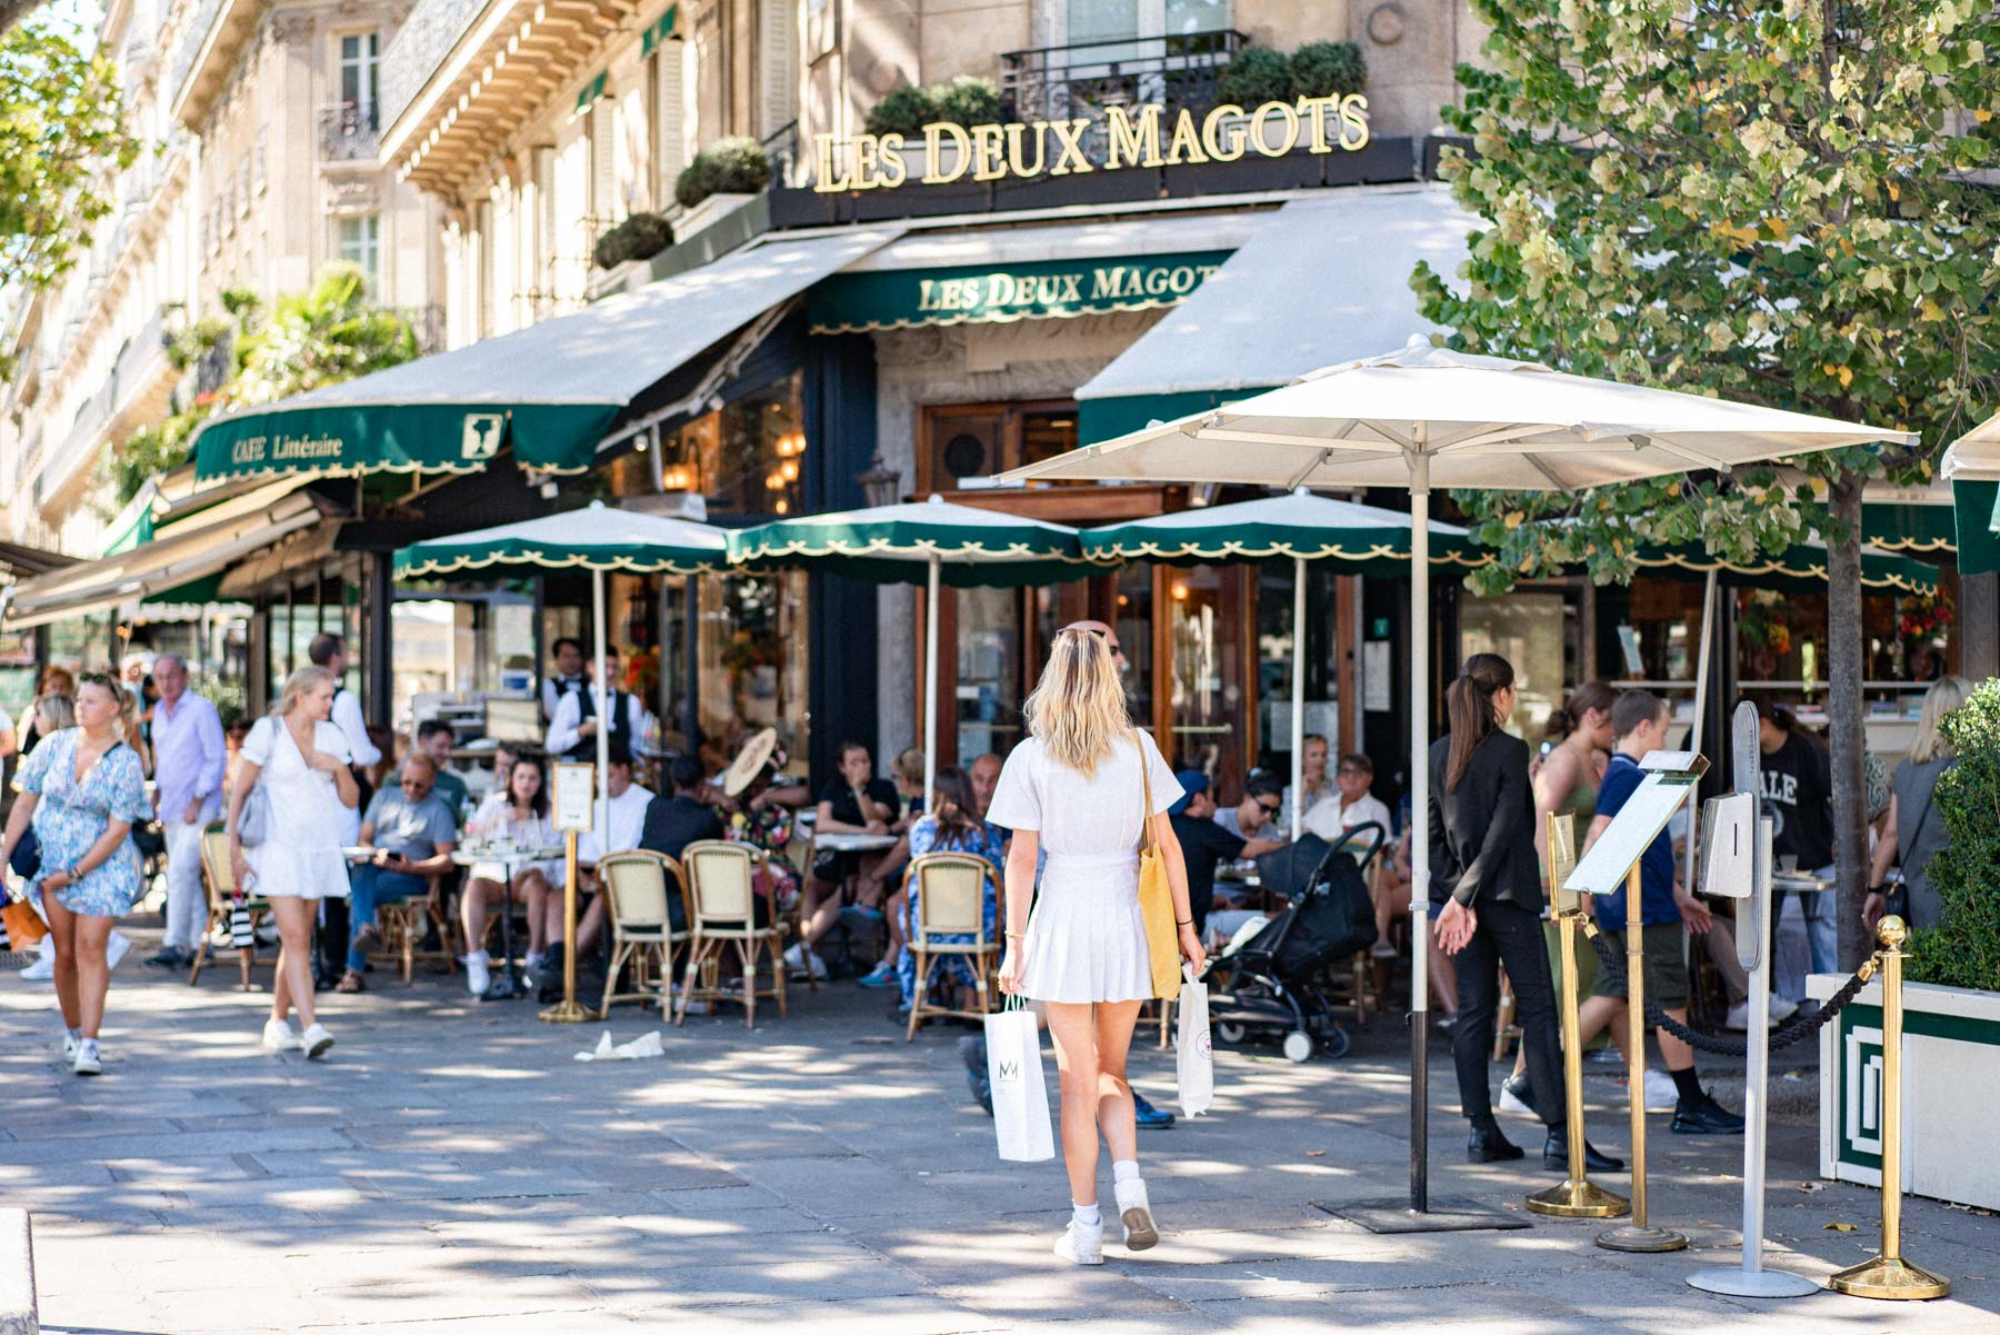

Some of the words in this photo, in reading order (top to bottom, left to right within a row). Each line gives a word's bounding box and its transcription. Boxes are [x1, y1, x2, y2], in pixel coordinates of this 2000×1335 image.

[813, 132, 906, 193] LES
[921, 119, 1091, 185] DEUX
[1105, 93, 1370, 170] MAGOTS
[917, 280, 979, 311] LES
[985, 273, 1083, 306] DEUX
[1091, 265, 1220, 299] MAGOT
[272, 433, 343, 459] Littéraire
